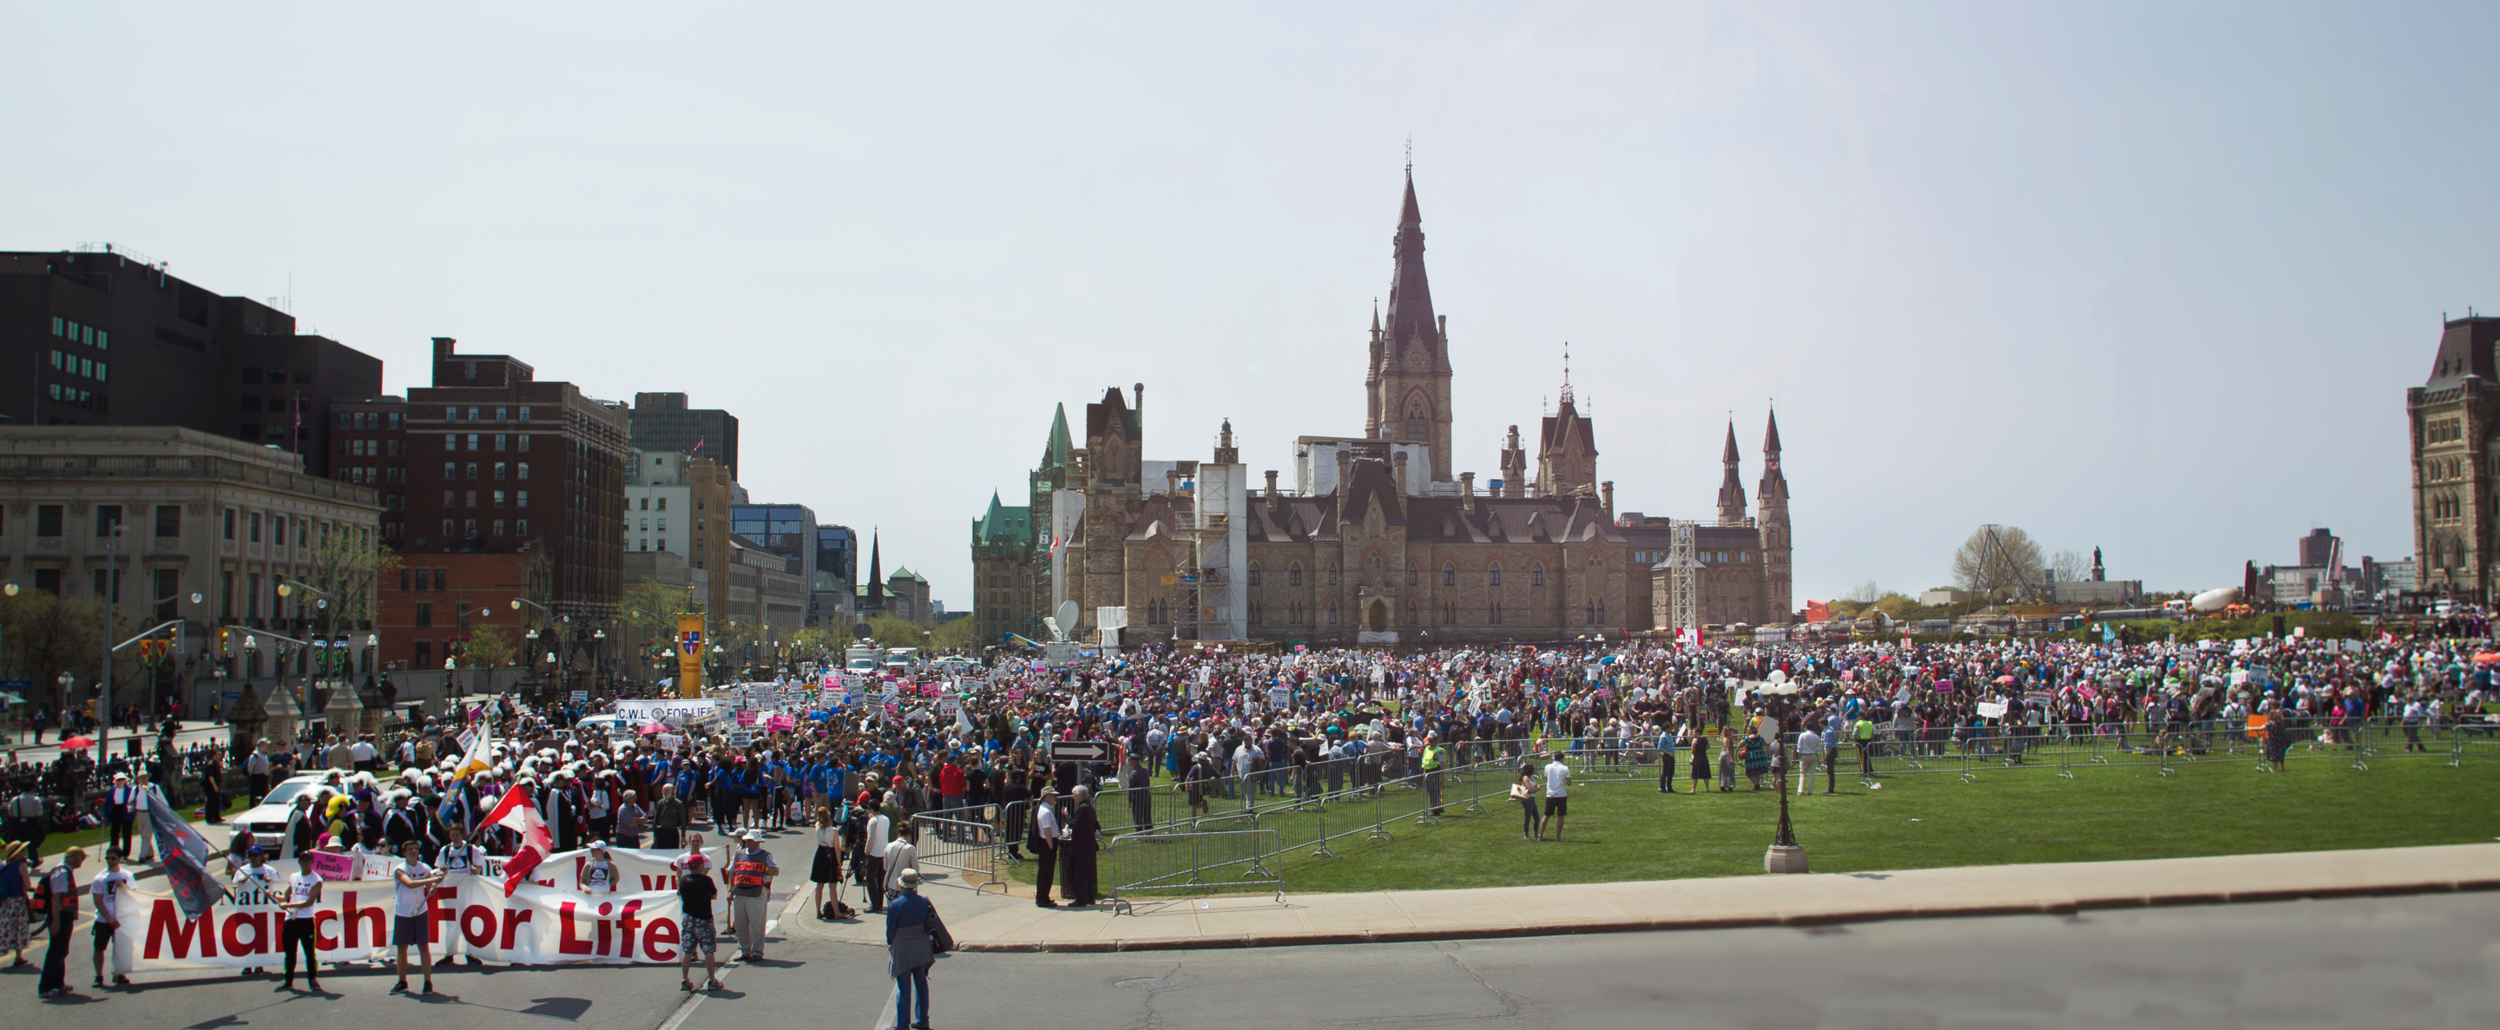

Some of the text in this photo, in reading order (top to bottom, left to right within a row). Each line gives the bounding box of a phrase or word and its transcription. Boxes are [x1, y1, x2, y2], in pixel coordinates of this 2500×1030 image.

[852, 701, 864, 709] LIFE
[618, 708, 650, 720] C.W.L.
[325, 855, 336, 863] End
[315, 860, 344, 873] Female
[143, 885, 681, 962] March For Life
